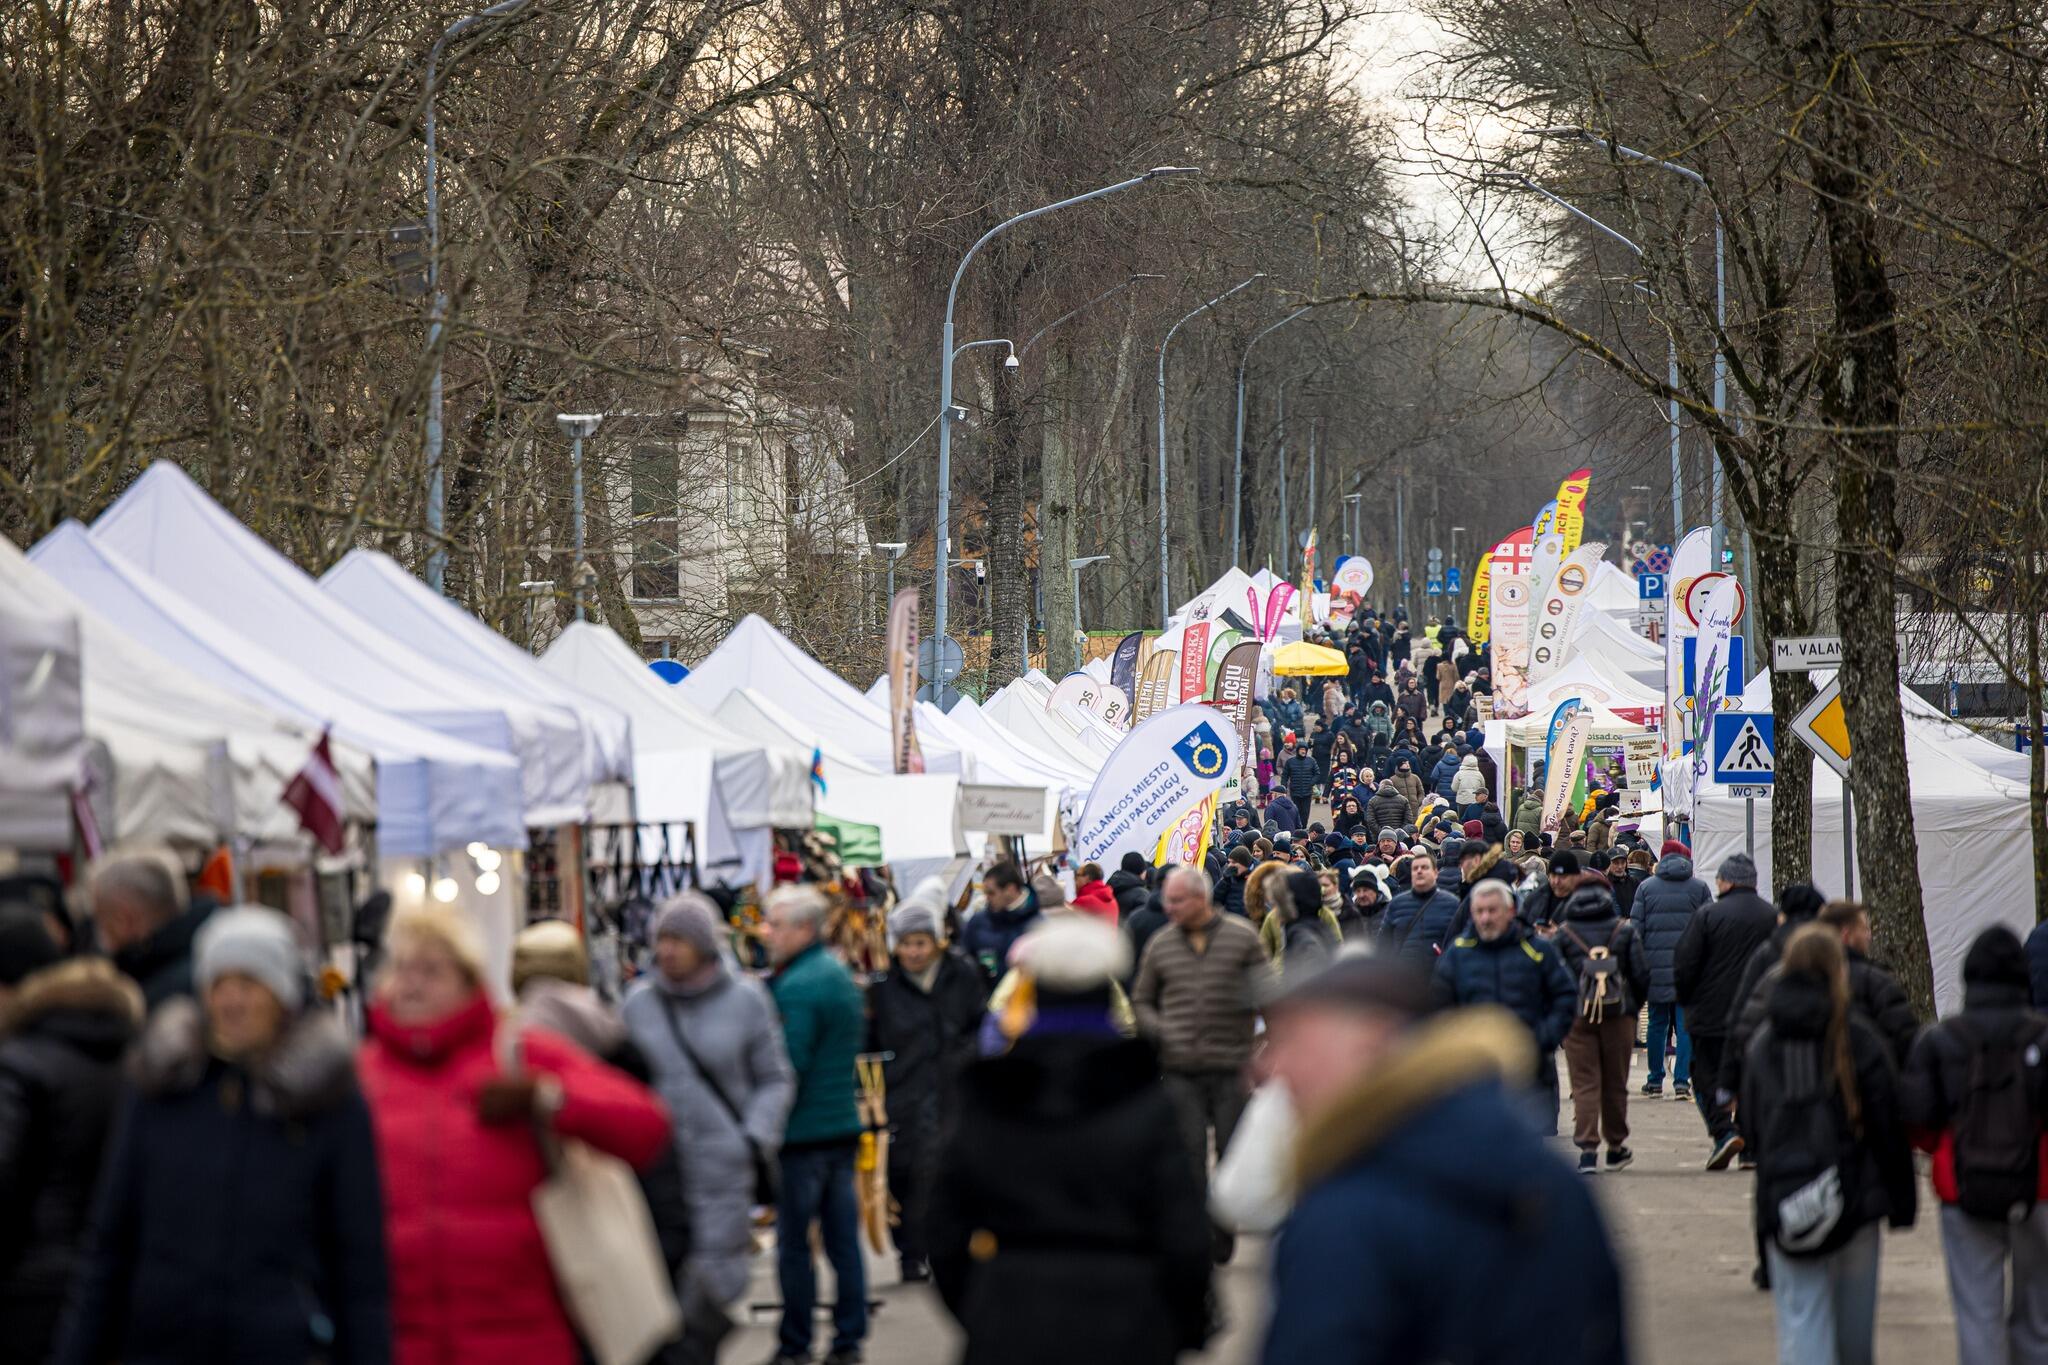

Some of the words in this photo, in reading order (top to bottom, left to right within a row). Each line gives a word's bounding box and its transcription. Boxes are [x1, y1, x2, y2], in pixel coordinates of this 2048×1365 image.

[1475, 585, 1488, 627] crunch
[1645, 576, 1660, 597] P
[1778, 644, 1792, 656] M.
[1799, 642, 1842, 656] VALAN
[1236, 677, 1251, 720] MEISTRAI
[1082, 793, 1134, 846] PALANGOS
[1132, 761, 1170, 797] MIESTO
[1146, 786, 1190, 827] CENTRAS
[1732, 787, 1752, 797] WC
[1084, 819, 1131, 862] CIALINIŲ
[1129, 773, 1181, 822] PASLAUGŲ
